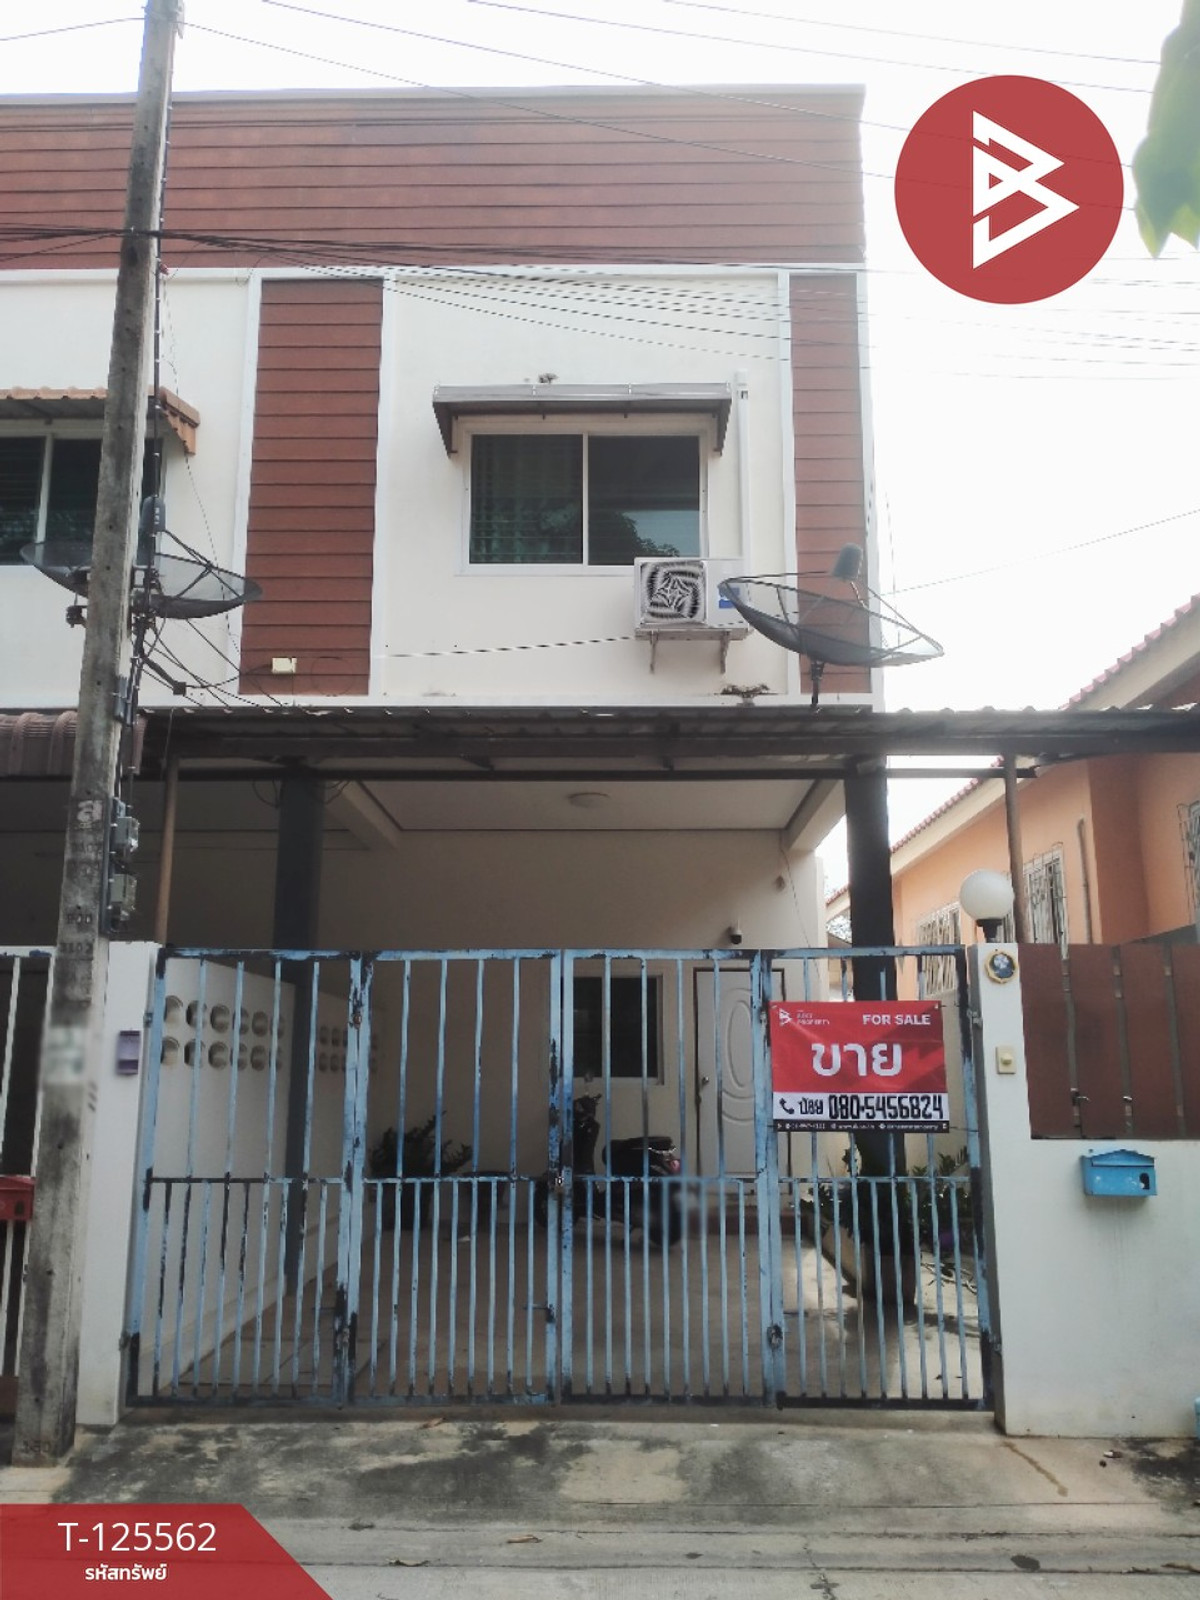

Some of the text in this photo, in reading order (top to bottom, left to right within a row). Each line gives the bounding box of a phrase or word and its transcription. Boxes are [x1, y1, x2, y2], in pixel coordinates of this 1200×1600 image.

[862, 1014, 931, 1025] FOR SALE
[811, 1043, 903, 1076] ขาย
[828, 1094, 943, 1120] 080-5456824
